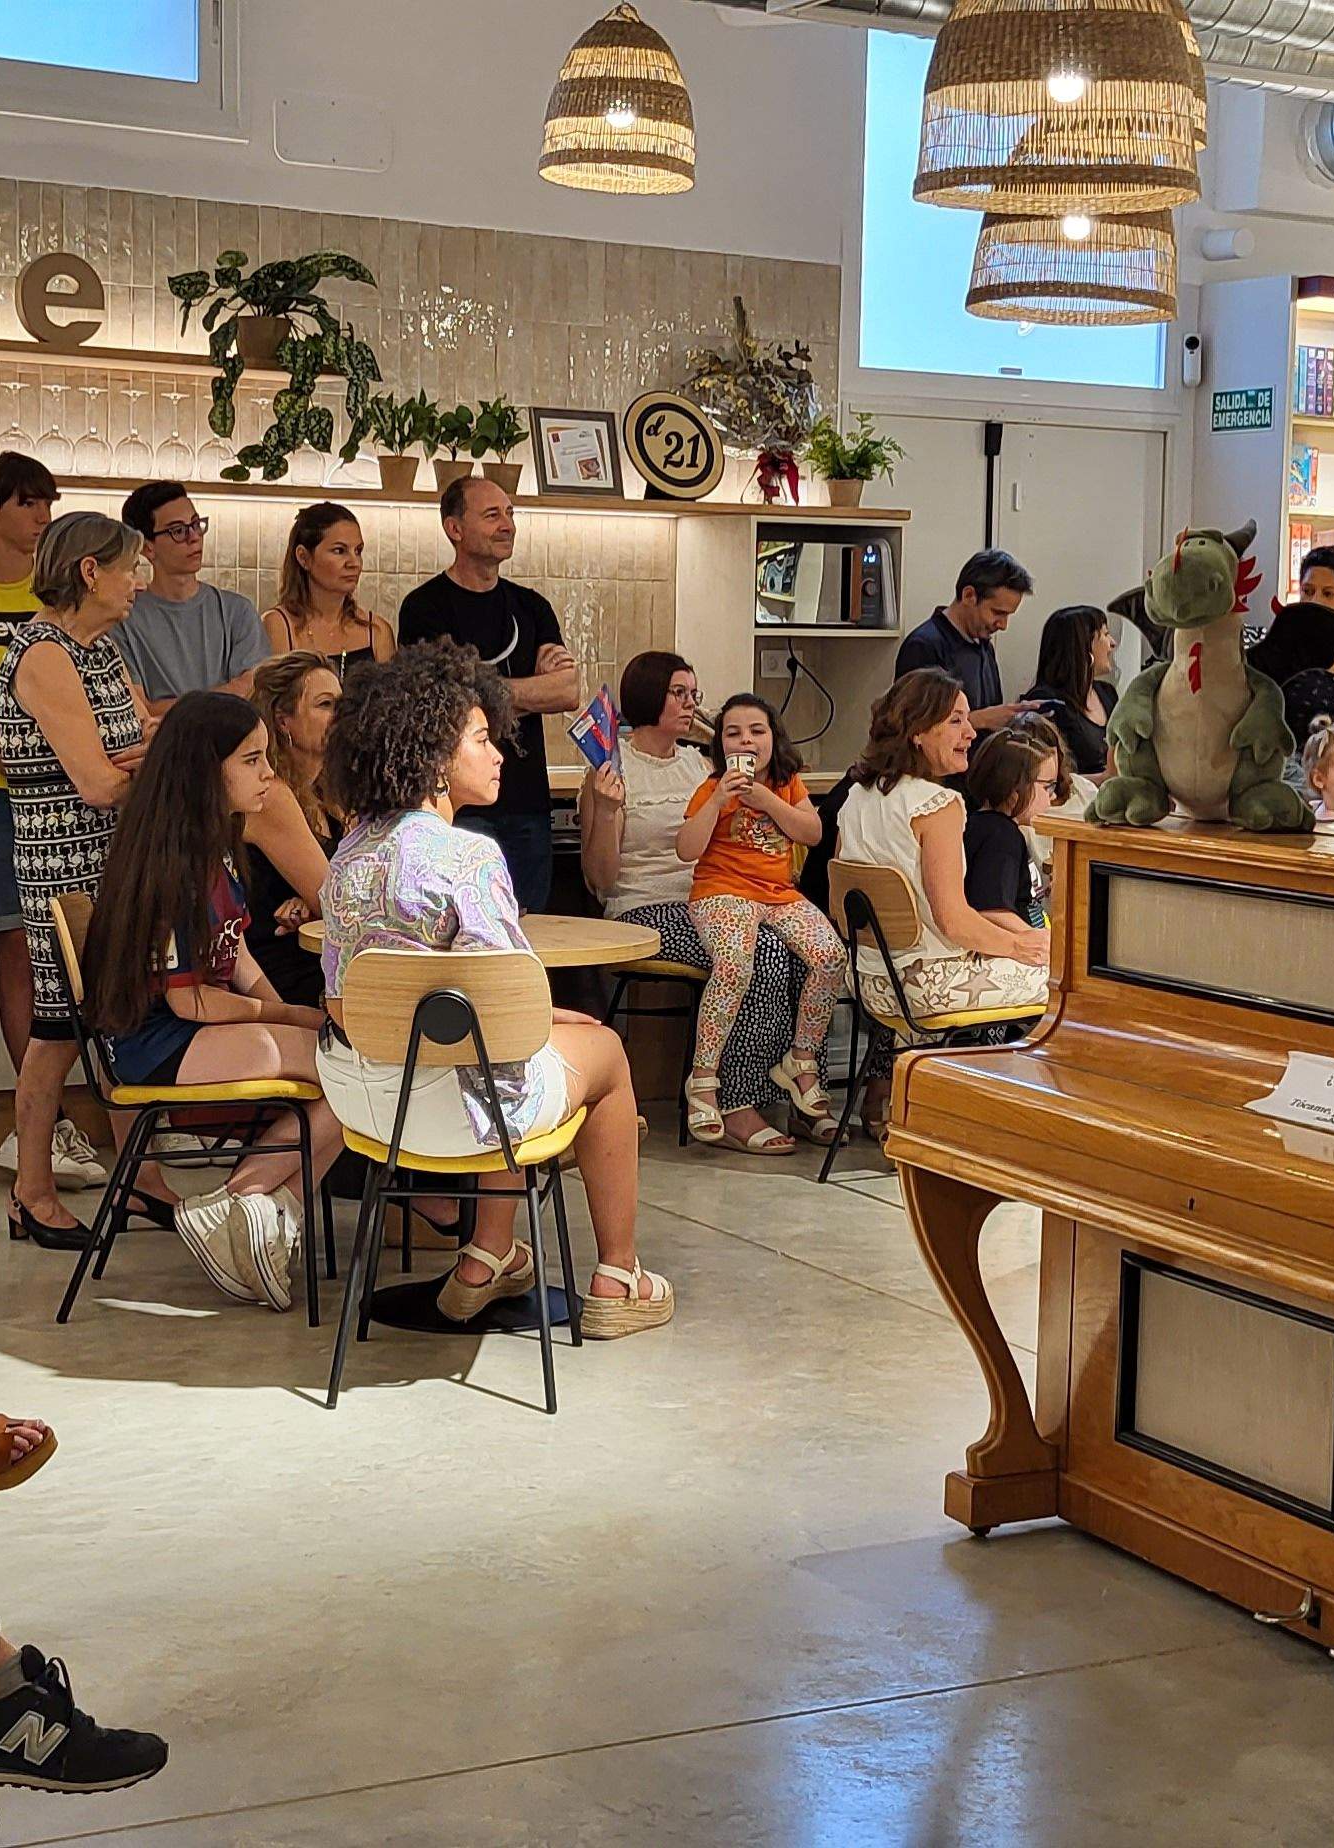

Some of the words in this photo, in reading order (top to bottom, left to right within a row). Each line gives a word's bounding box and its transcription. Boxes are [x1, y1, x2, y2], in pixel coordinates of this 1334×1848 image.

[1214, 391, 1247, 411] SALIDA
[1257, 389, 1271, 408] DE
[1212, 407, 1271, 429] EMERGENCIA
[662, 430, 702, 470] 21
